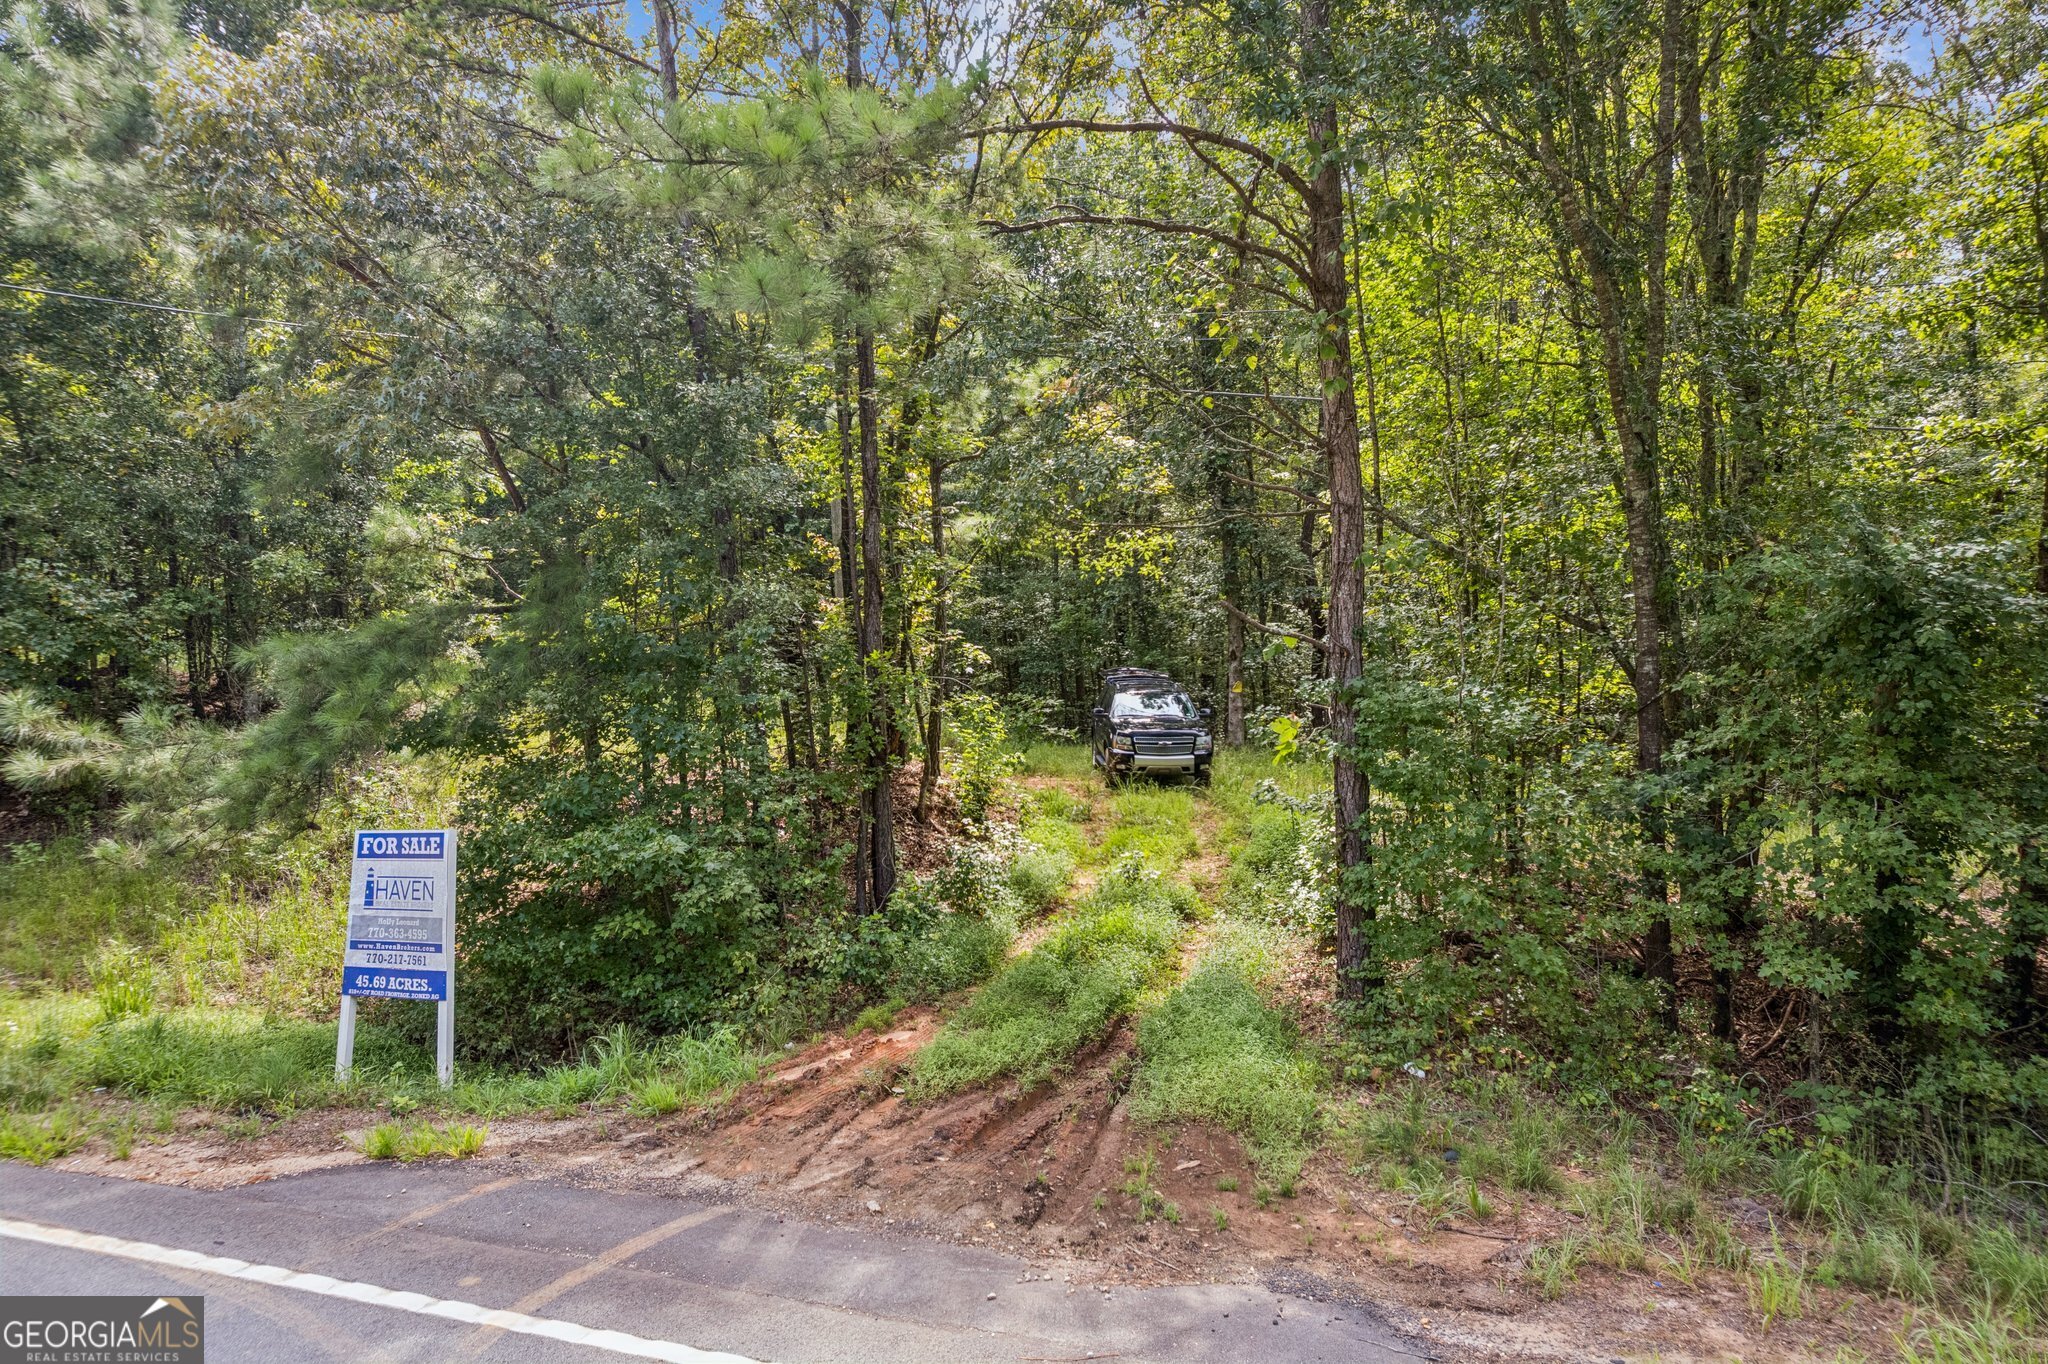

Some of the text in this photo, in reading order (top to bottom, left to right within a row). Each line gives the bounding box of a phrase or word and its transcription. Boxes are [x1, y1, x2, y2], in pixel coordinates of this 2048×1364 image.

[361, 837, 440, 854] FOR SALE
[375, 880, 434, 901] HAVEN
[367, 928, 427, 940] 770-363-4595
[357, 943, 436, 952] www.HavenBrokers.com
[366, 953, 427, 966] 770-217-7561
[355, 975, 433, 991] 45.69 ACRES.
